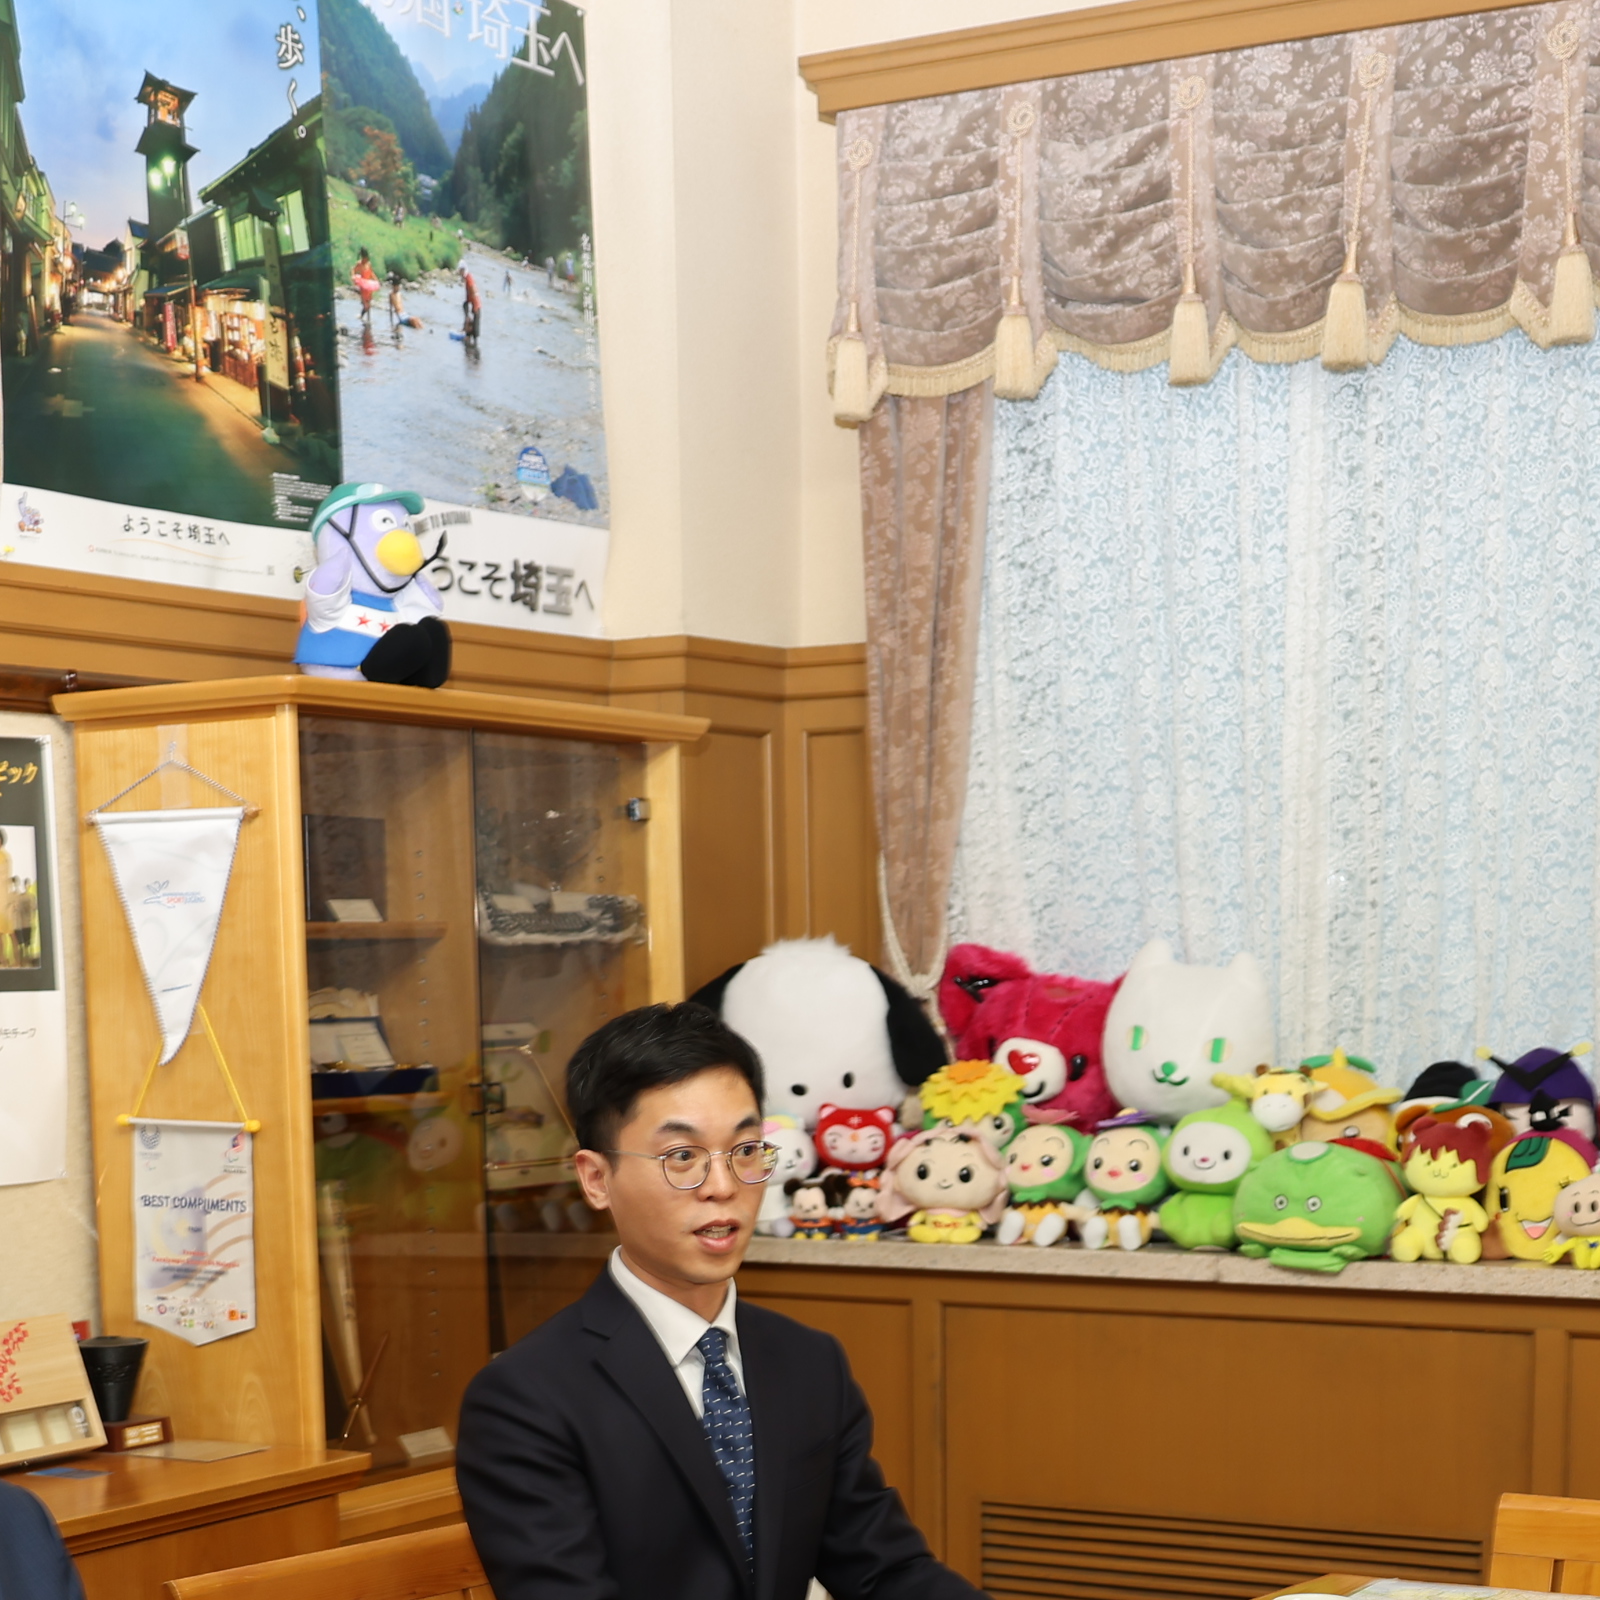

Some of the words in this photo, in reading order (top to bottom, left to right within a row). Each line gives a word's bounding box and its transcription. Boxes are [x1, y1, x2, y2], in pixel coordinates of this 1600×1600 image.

[122, 513, 231, 546] ようこそ埼玉へ
[140, 1194, 172, 1208] BEST
